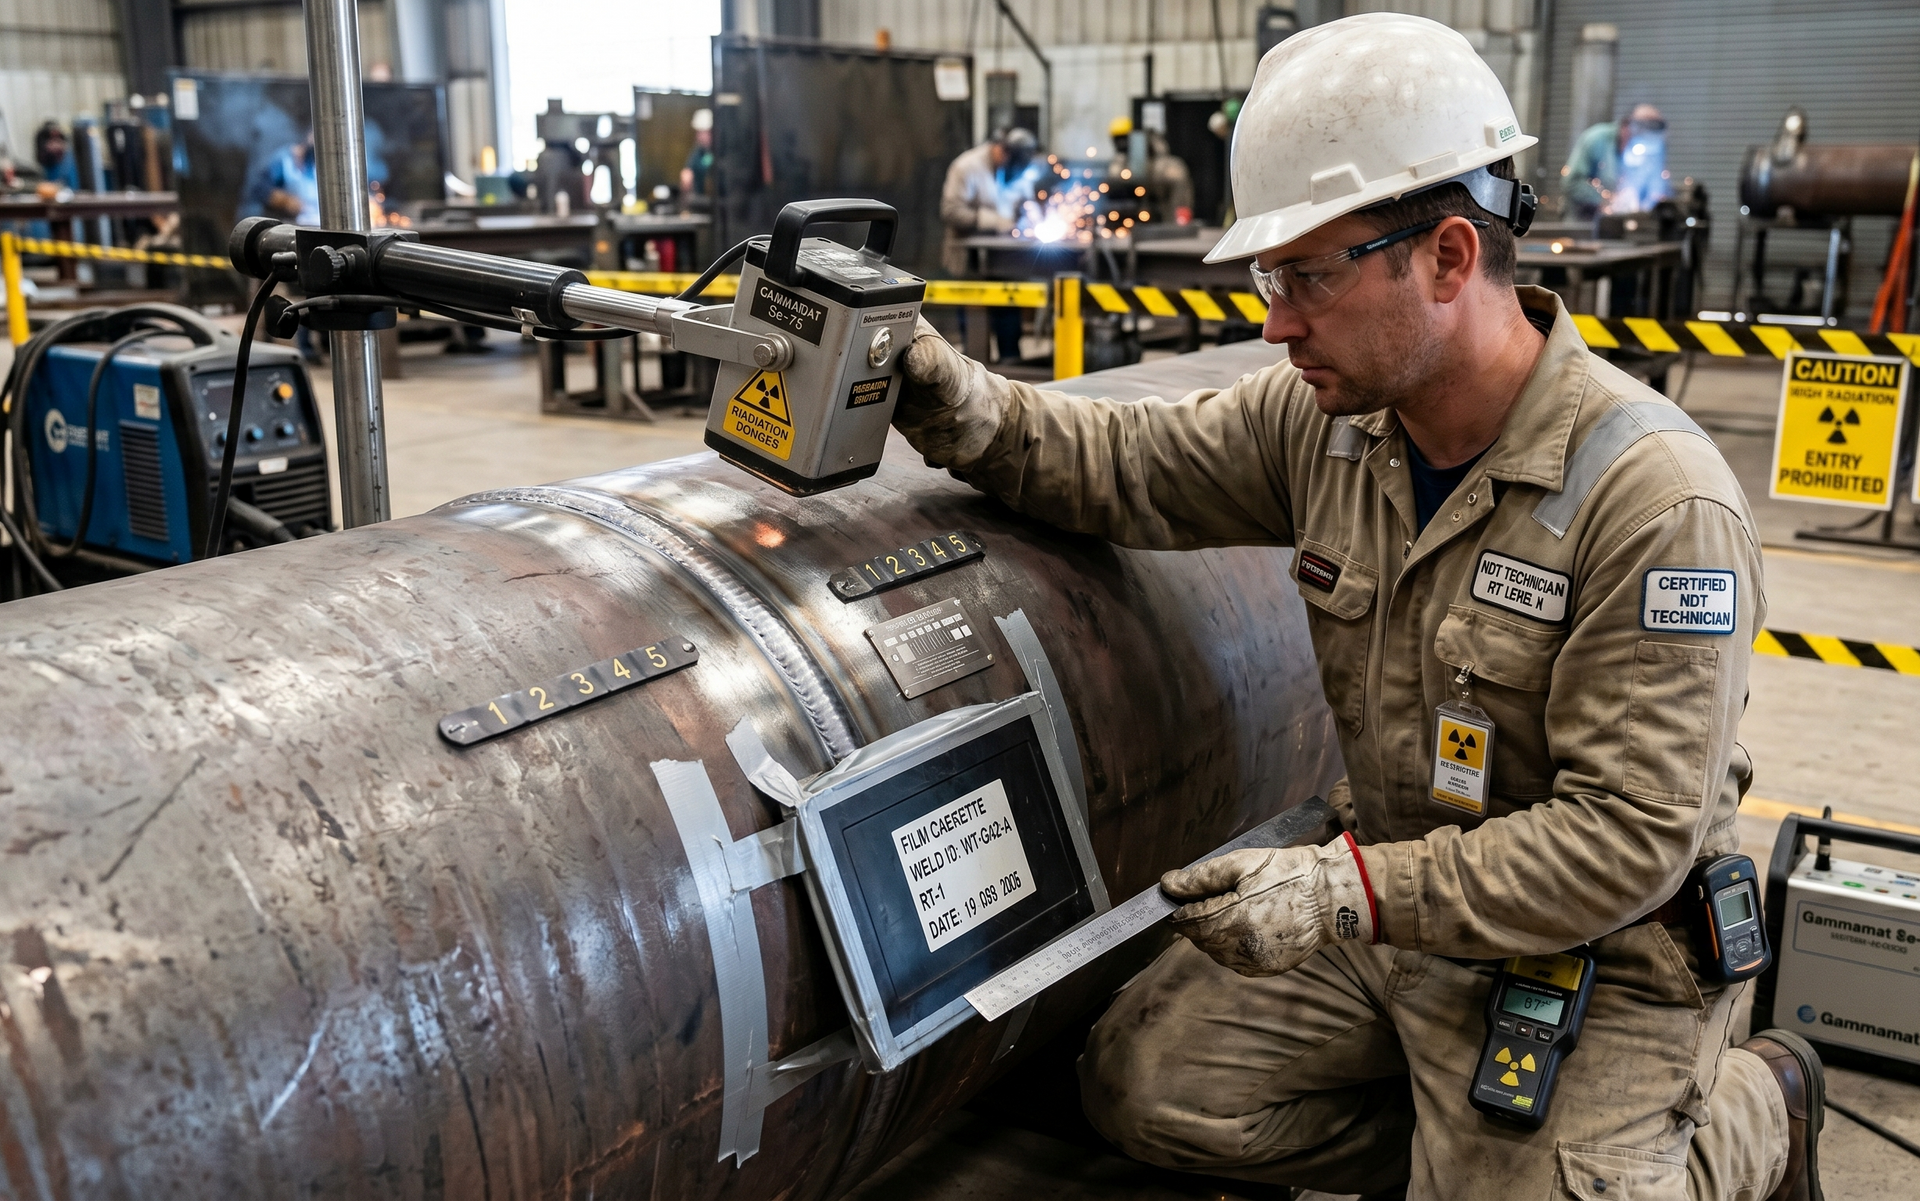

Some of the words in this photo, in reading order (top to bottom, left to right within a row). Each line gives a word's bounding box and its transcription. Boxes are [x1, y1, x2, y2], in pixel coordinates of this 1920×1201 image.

[768, 304, 804, 330] Se-75
[1794, 358, 1896, 387] CAUTION
[1826, 388, 1896, 406] RADIATION
[731, 405, 789, 441] RIADIATION
[735, 421, 780, 449] DONGES
[1804, 449, 1863, 471] ENTRY
[1778, 467, 1885, 495] PROHIBITED
[865, 563, 881, 581] 1
[885, 555, 906, 575] 2
[908, 548, 926, 567] 3
[931, 541, 948, 558] 4
[948, 534, 967, 553] 5
[1480, 559, 1503, 578] NDT
[1504, 566, 1566, 598] TECHNICIAN
[1487, 580, 1504, 596] RT
[1658, 576, 1727, 592] CERTIFIED
[1679, 593, 1708, 608] NDT
[1650, 609, 1731, 626] TECHNICIAN
[488, 701, 508, 725] 1
[529, 686, 555, 710] 2
[570, 672, 595, 695] 3
[613, 658, 631, 679] 4
[645, 646, 667, 668] 5
[900, 826, 930, 855] FILM
[909, 851, 945, 882] WELD
[919, 882, 946, 911] RT-1
[928, 907, 963, 940] DATE:
[964, 897, 977, 919] 19
[1802, 910, 1892, 940] Gammamat
[1820, 1011, 1920, 1046] Gammamat
